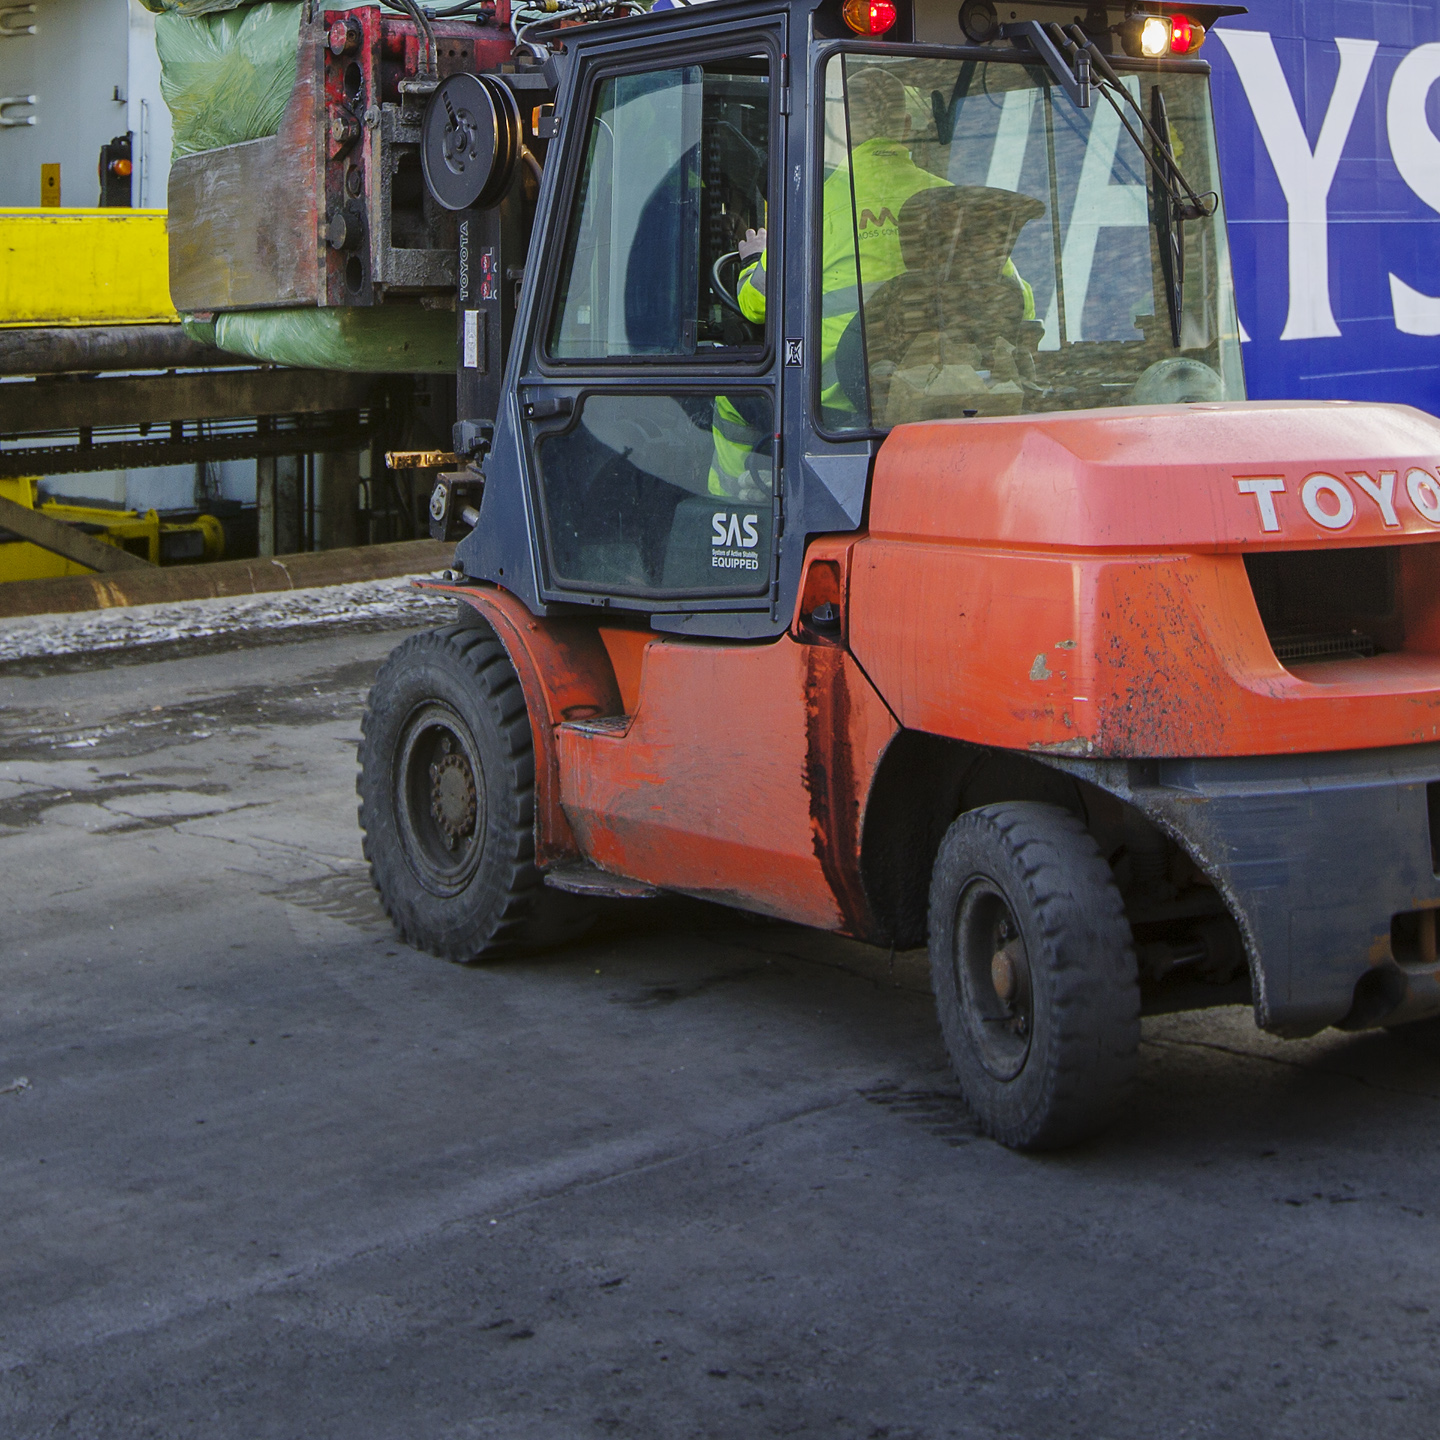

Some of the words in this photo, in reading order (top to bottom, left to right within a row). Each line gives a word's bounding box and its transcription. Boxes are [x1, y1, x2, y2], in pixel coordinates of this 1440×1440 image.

[459, 220, 469, 301] TOYOTA
[711, 512, 759, 548] SAS
[711, 557, 759, 570] EQUIPPED
